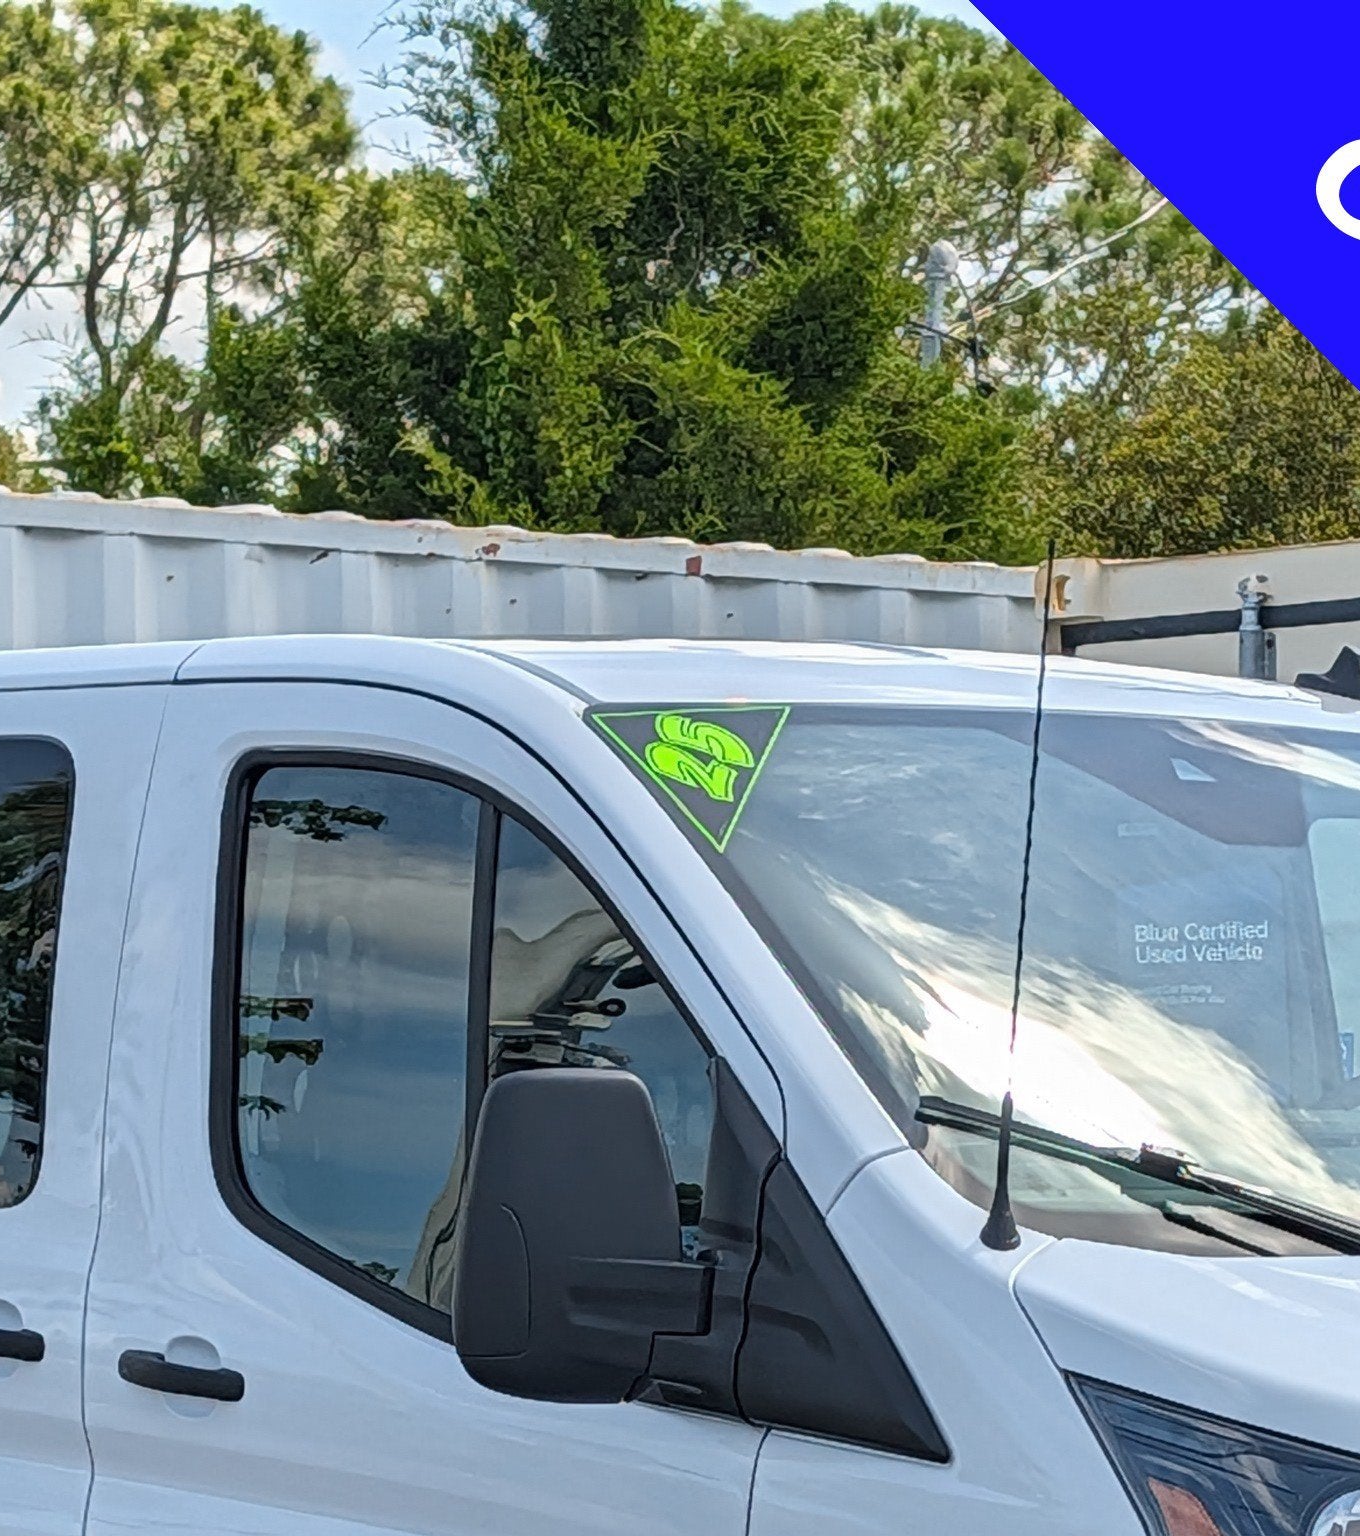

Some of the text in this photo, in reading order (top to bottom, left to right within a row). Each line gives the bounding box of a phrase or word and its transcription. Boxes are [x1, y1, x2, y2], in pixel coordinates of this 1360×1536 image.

[645, 714, 755, 803] 25
[1135, 920, 1269, 942] Blue Certified
[1136, 942, 1263, 963] Used Vehicle
